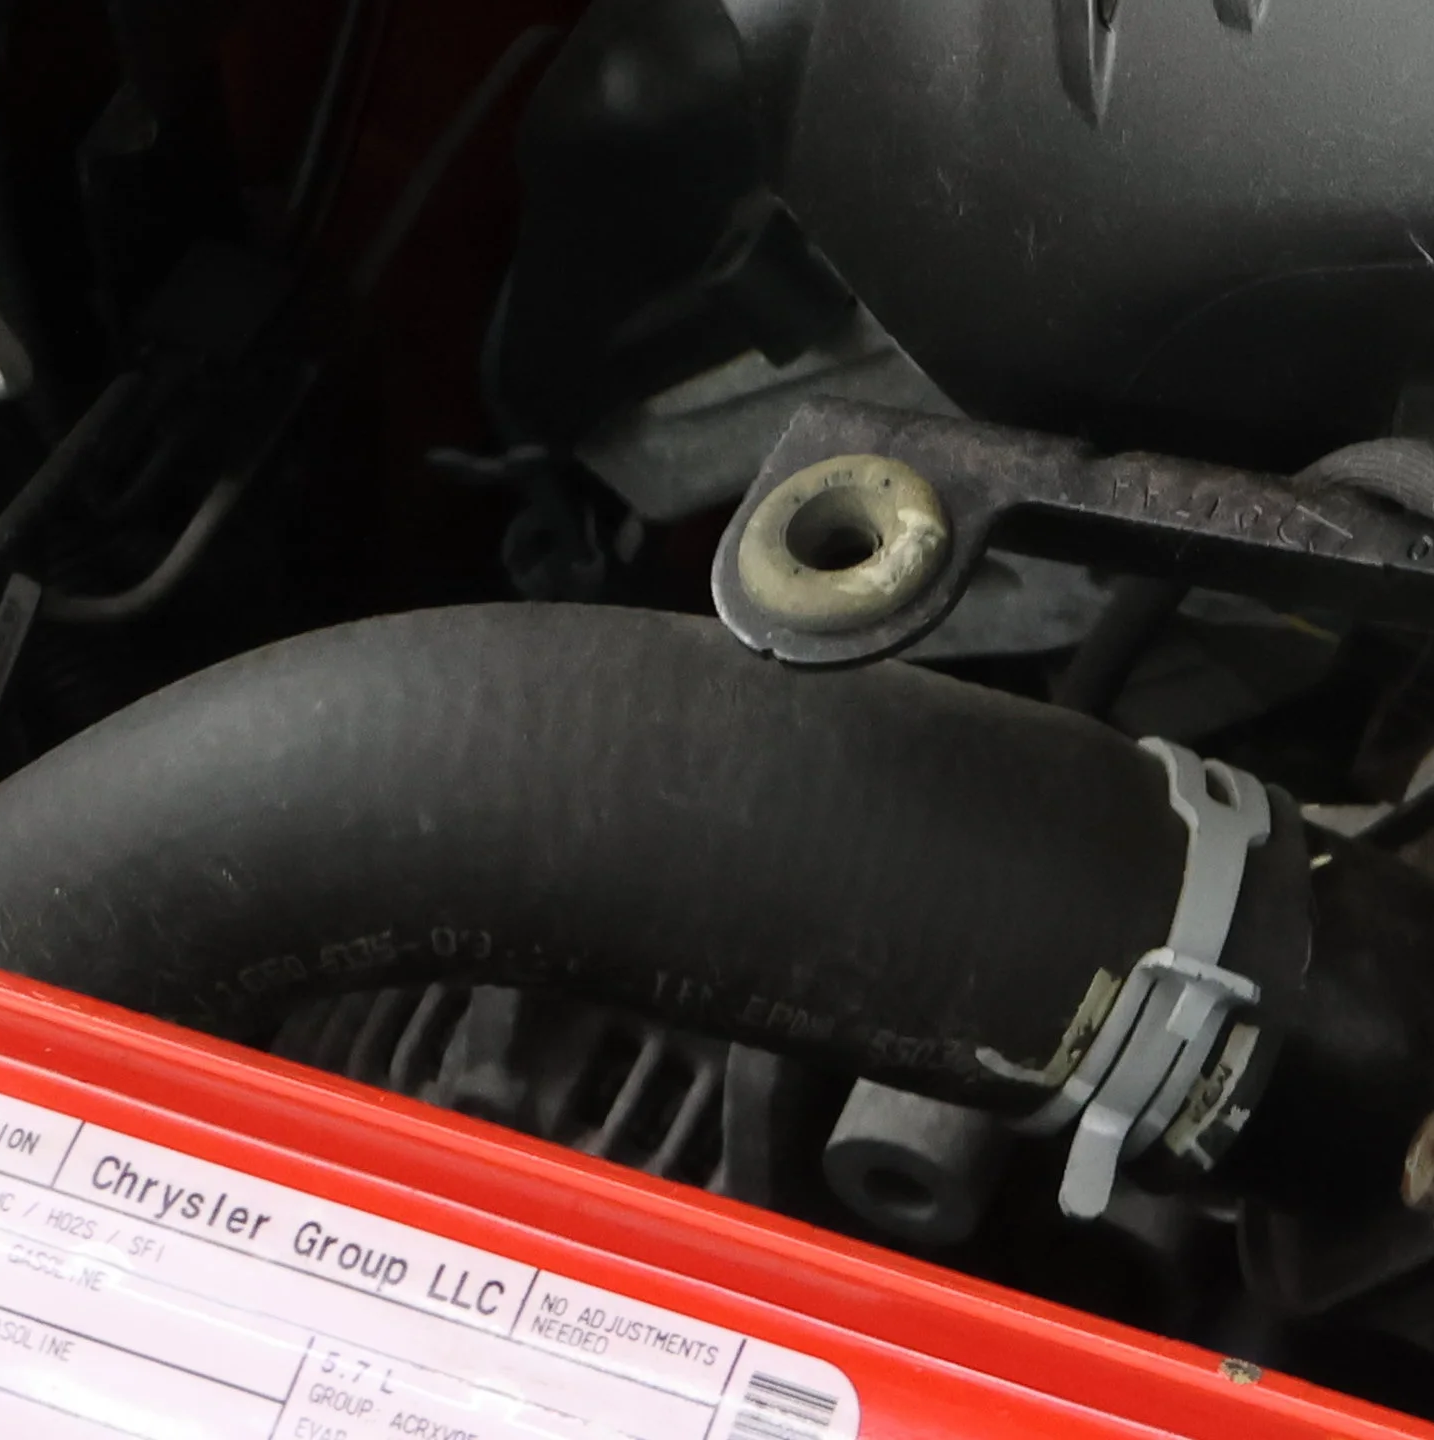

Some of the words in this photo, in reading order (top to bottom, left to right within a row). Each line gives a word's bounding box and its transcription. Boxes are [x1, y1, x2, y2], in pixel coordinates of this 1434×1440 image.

[22, 1201, 39, 1219] /
[46, 1207, 100, 1240] HO2S
[106, 1229, 121, 1245] /
[127, 1234, 165, 1262] SFI
[90, 1154, 272, 1241] Chrysler
[292, 1219, 409, 1289] Group
[426, 1263, 506, 1318] LLC
[530, 1315, 609, 1356] NEEDED
[540, 1291, 570, 1317] NO
[577, 1305, 721, 1367] ADJUSTMENTS
